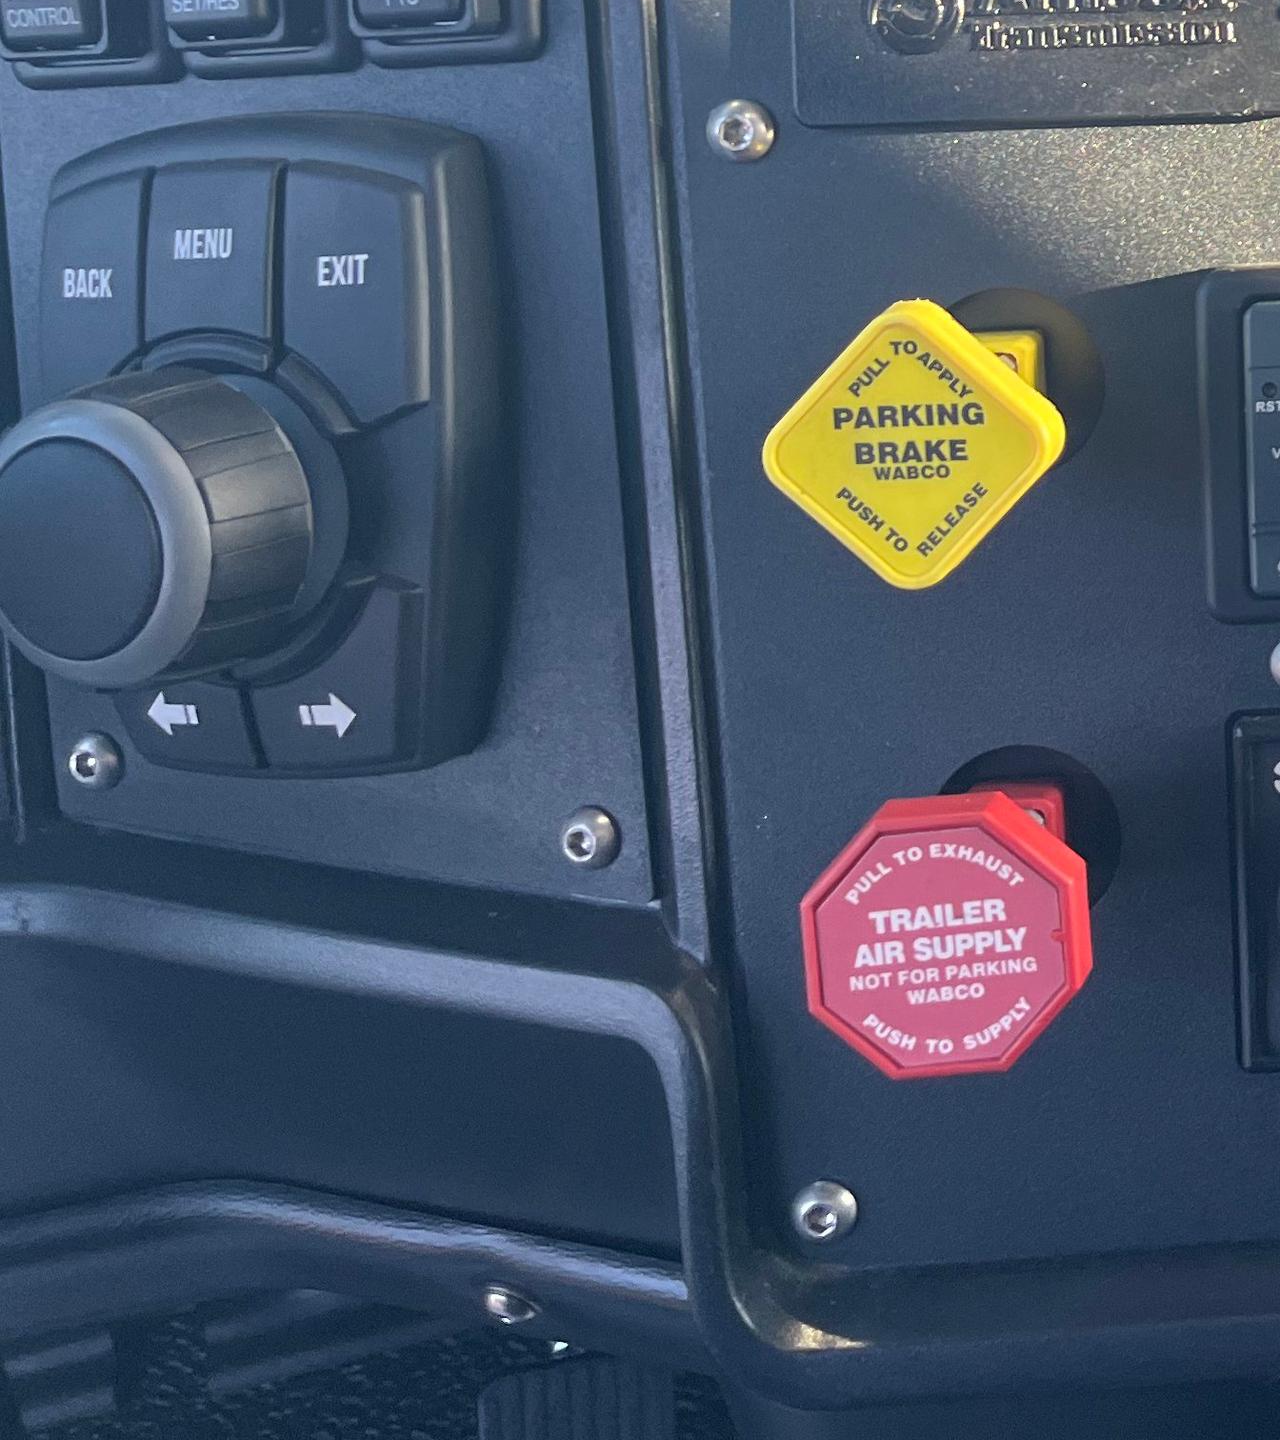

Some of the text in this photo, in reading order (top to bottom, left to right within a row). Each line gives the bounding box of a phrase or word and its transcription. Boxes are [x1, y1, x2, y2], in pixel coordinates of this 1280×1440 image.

[7, 6, 80, 28] CONTROL
[174, 228, 233, 260] MENU
[64, 269, 113, 298] BACK
[317, 254, 368, 287] EXIT
[848, 340, 974, 399] PULL TO APPLY
[832, 402, 985, 430] PARKING
[854, 439, 968, 465] BRAKE
[873, 464, 951, 481] WABCO
[836, 481, 988, 558] PUSH TO RELEASE
[844, 843, 1025, 906] PULL TO EXHAUST
[868, 898, 1006, 935] TRAILER
[854, 927, 1028, 968] AIR SUPPLY
[849, 956, 1037, 991] NOT FOR PARKING
[906, 983, 985, 1005] WABCO
[862, 996, 1031, 1054] PUSH TO SUPPLY
